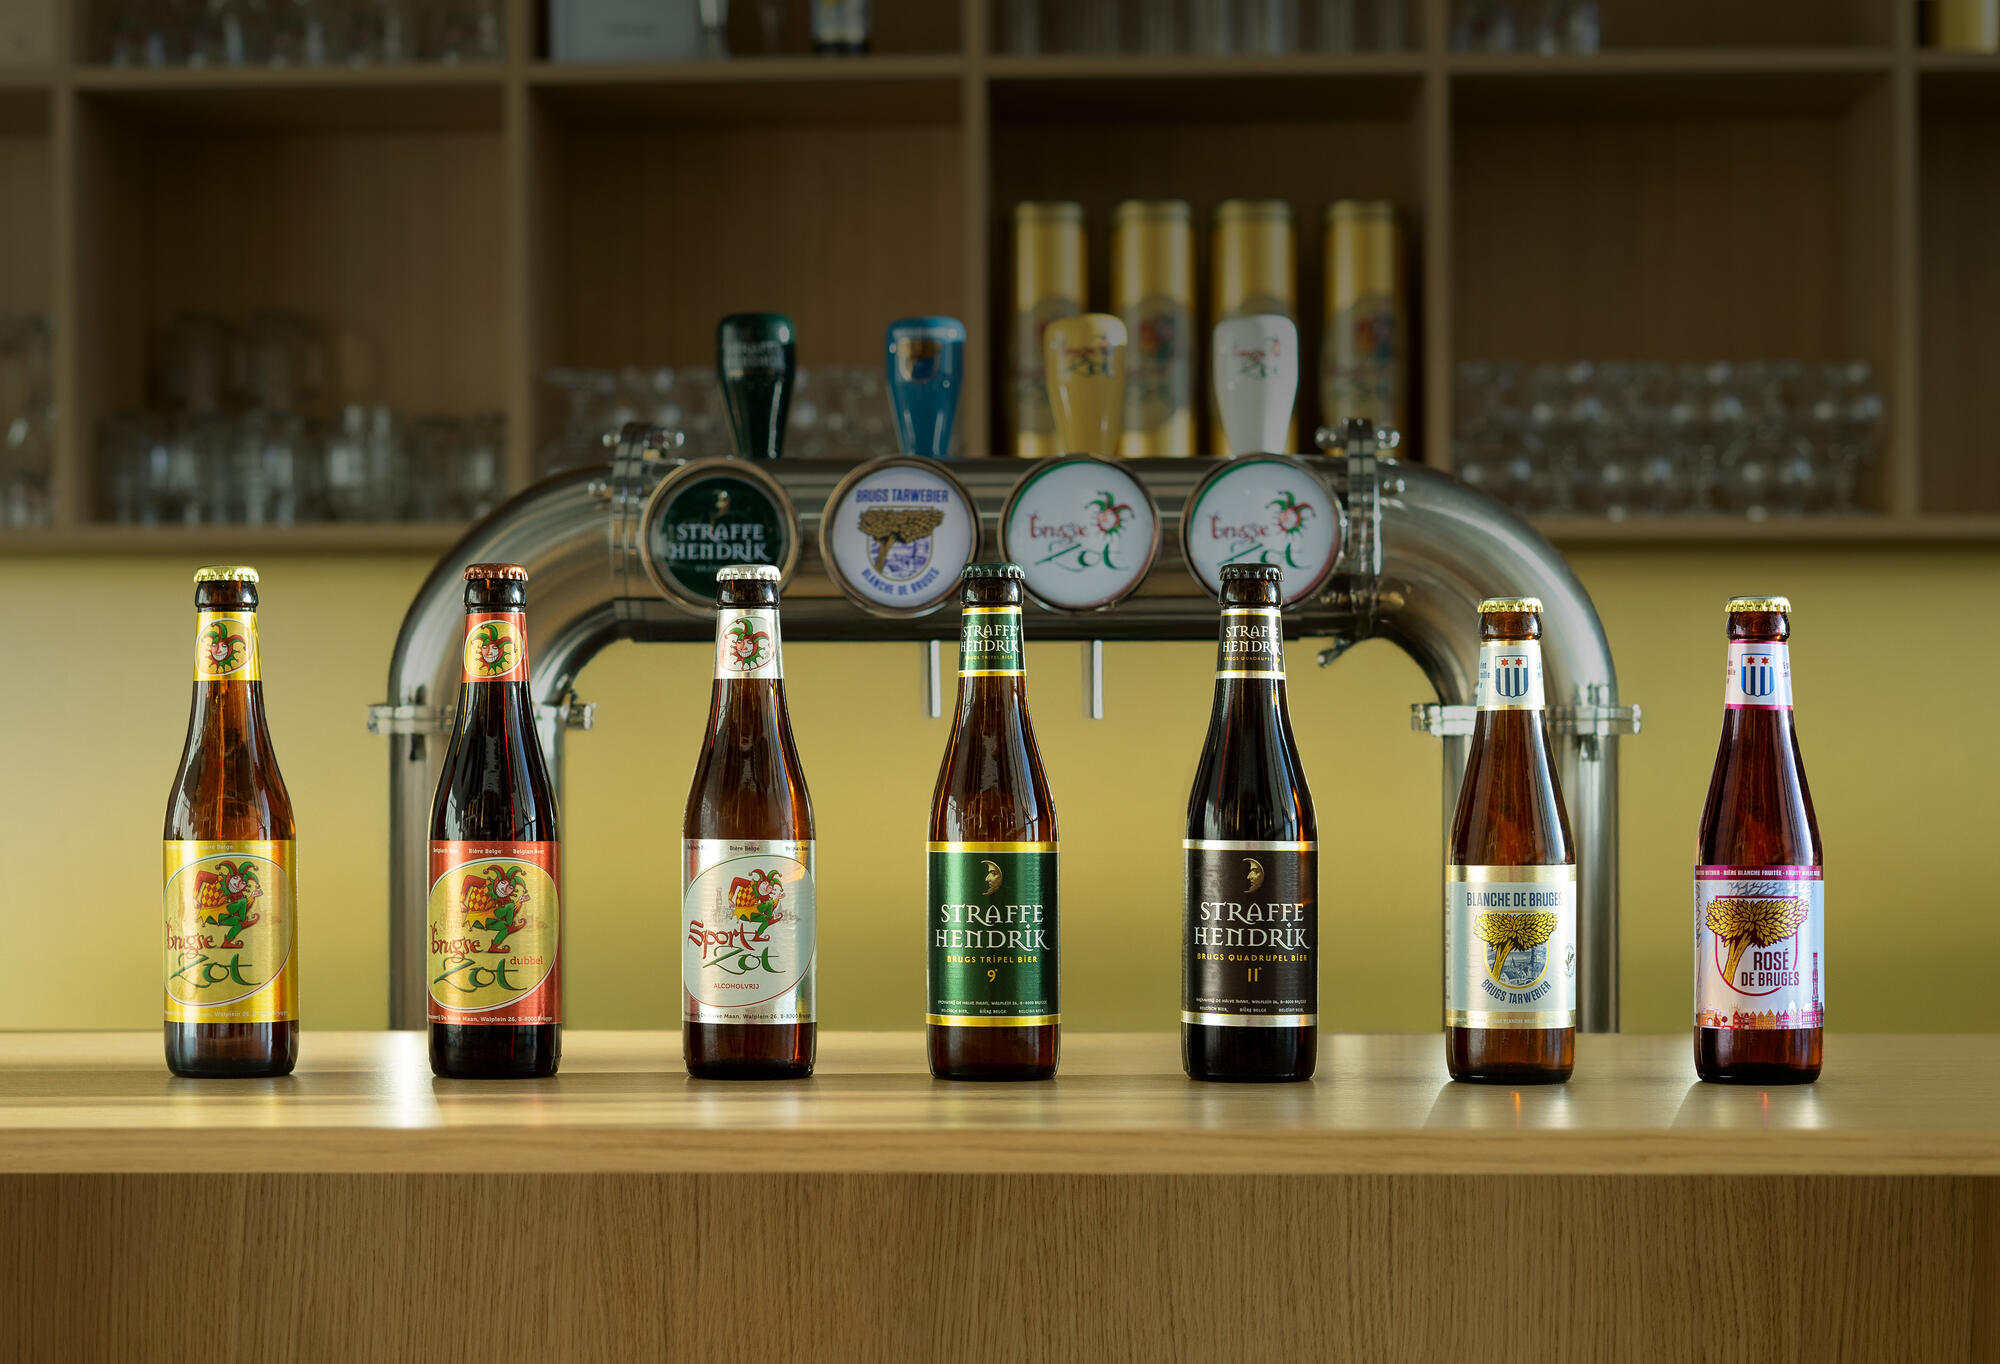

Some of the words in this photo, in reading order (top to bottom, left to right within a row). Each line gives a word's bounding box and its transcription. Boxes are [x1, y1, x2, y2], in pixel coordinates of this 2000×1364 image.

[856, 488, 889, 503] BRUGS
[891, 488, 949, 502] TARWEBIER
[676, 523, 765, 543] STRAFFE
[669, 542, 773, 562] HENDRIK
[963, 623, 1018, 639] STRAFFE
[1225, 625, 1279, 639] STRAFE
[960, 636, 1020, 653] HENDRIK
[1222, 640, 1282, 656] HENDRK
[1466, 892, 1511, 907] BLANCHE
[1513, 892, 1527, 907] DE
[940, 903, 1044, 926] STRAFFE
[1200, 901, 1305, 925] STRAFFE
[688, 919, 756, 960] Sport
[935, 924, 1051, 952] HENDRIK
[1193, 922, 1311, 950] HENDRIK
[509, 955, 544, 966] dubbel
[946, 955, 977, 964] BRUGS
[980, 954, 1014, 964] TRIPEL
[1017, 954, 1038, 964] BIER
[1197, 952, 1225, 961] BRUGS
[1228, 953, 1288, 962] QUADRUPEL
[1291, 953, 1308, 962] BIER
[1753, 948, 1789, 971] ROSÉ
[713, 982, 760, 990] ALCOHOLVRIJ
[1741, 971, 1755, 987] DE
[1758, 971, 1800, 987] BRUGES
[1481, 978, 1507, 1002] BRUGS
[1509, 981, 1552, 1005] TARWEBIER
